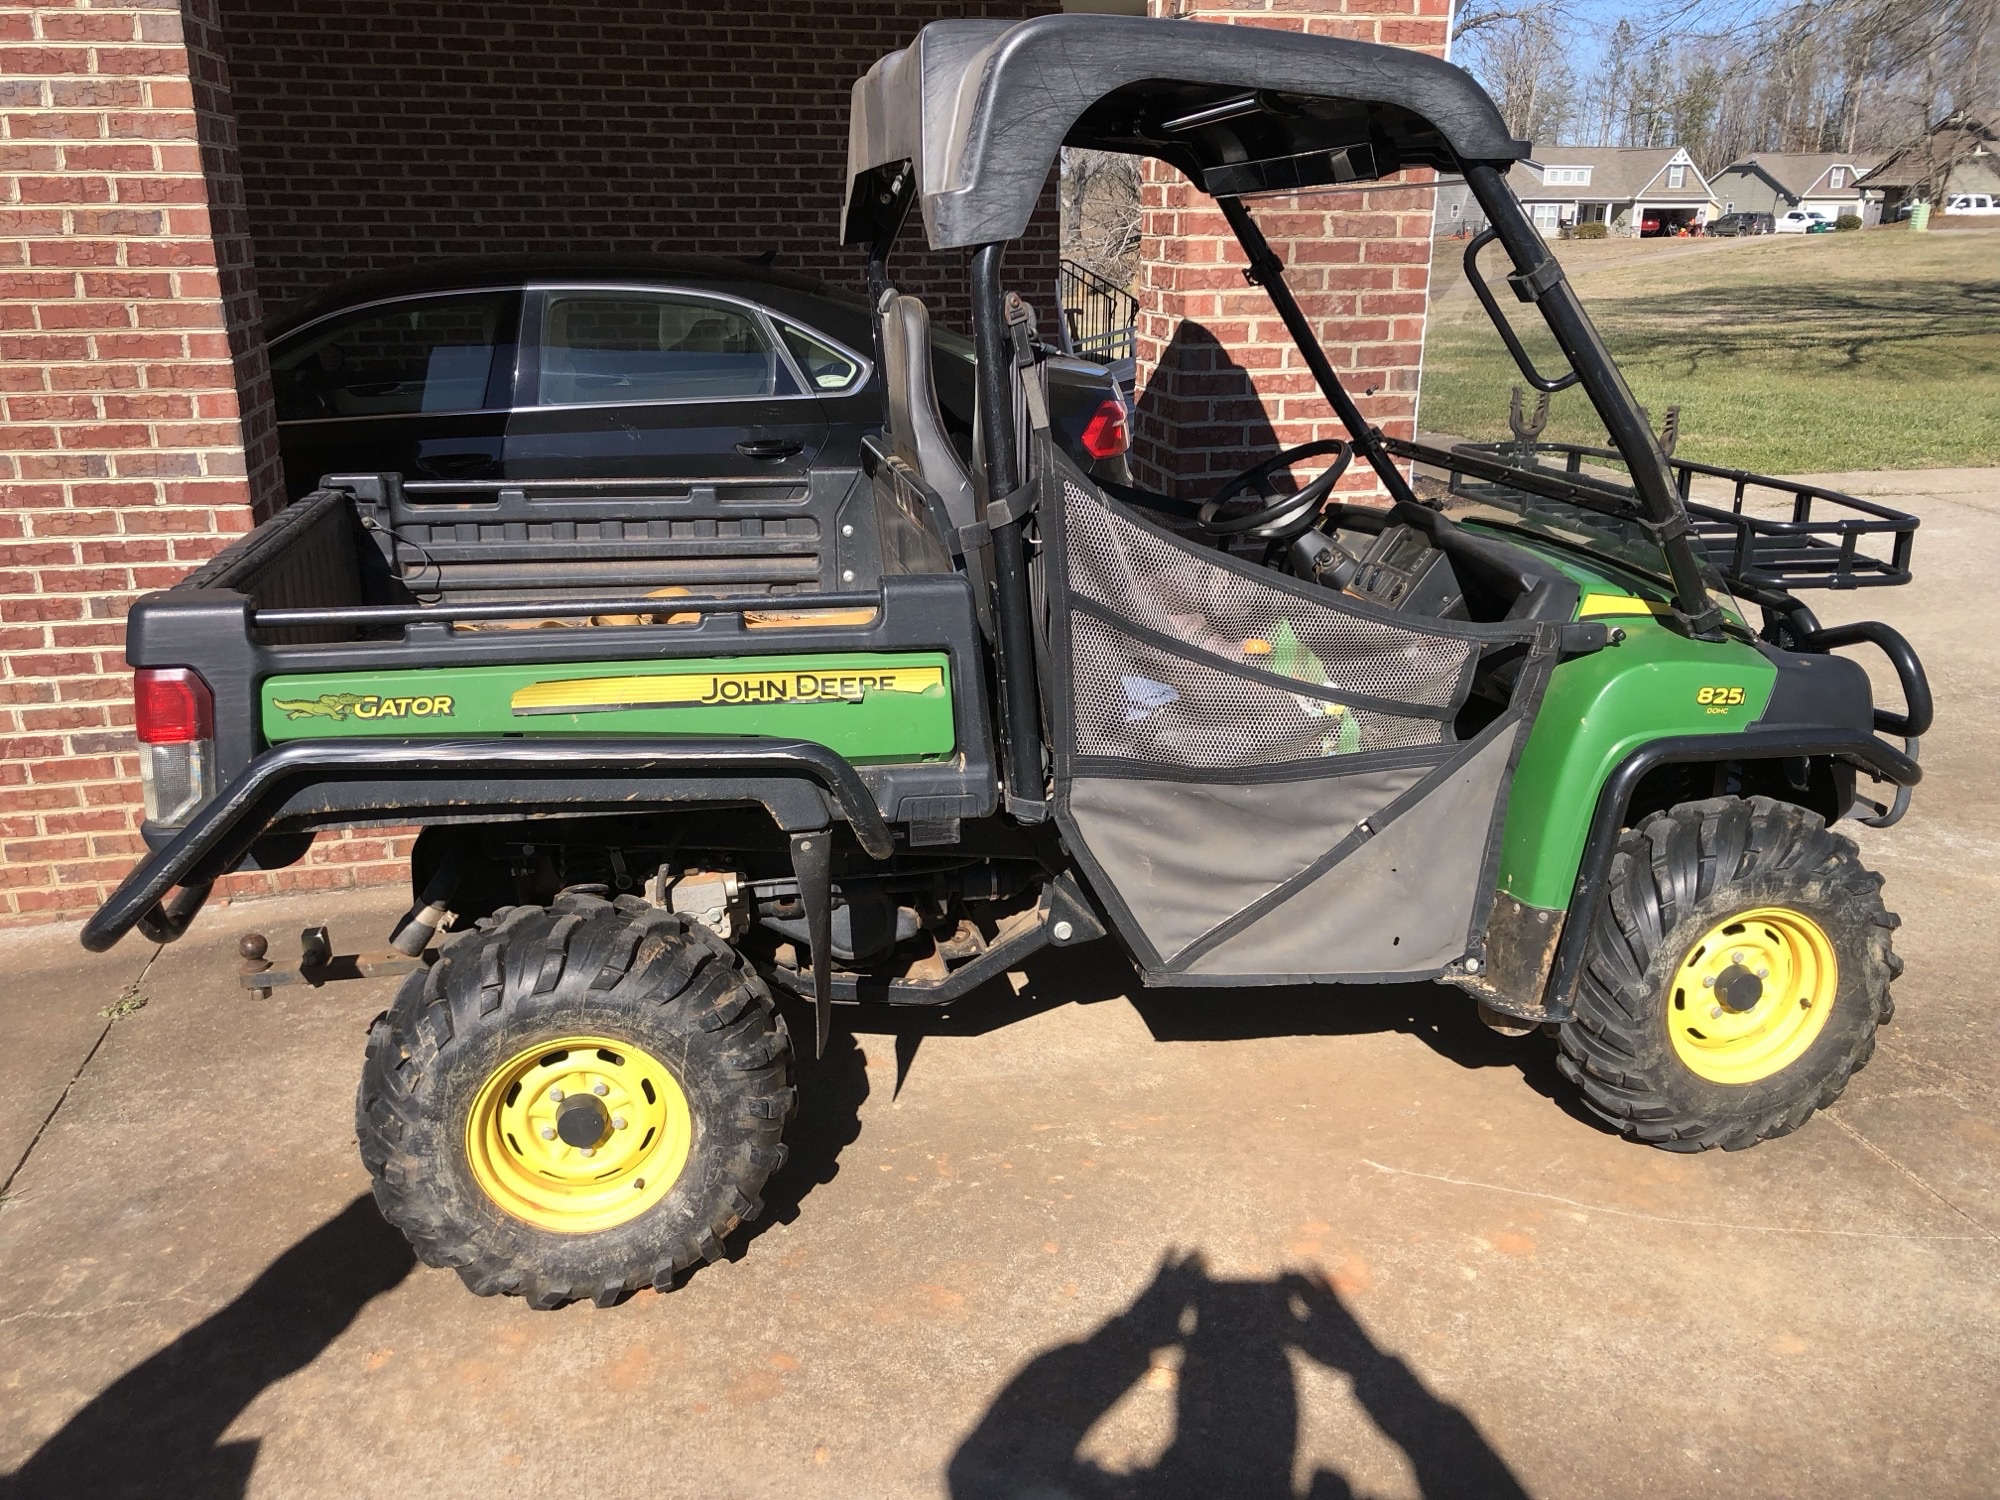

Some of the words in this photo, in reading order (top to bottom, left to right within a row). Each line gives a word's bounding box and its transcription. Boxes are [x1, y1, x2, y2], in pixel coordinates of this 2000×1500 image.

[702, 677, 787, 701] JOHN
[354, 695, 455, 720] GATOR
[1706, 707, 1729, 715] DOHC
